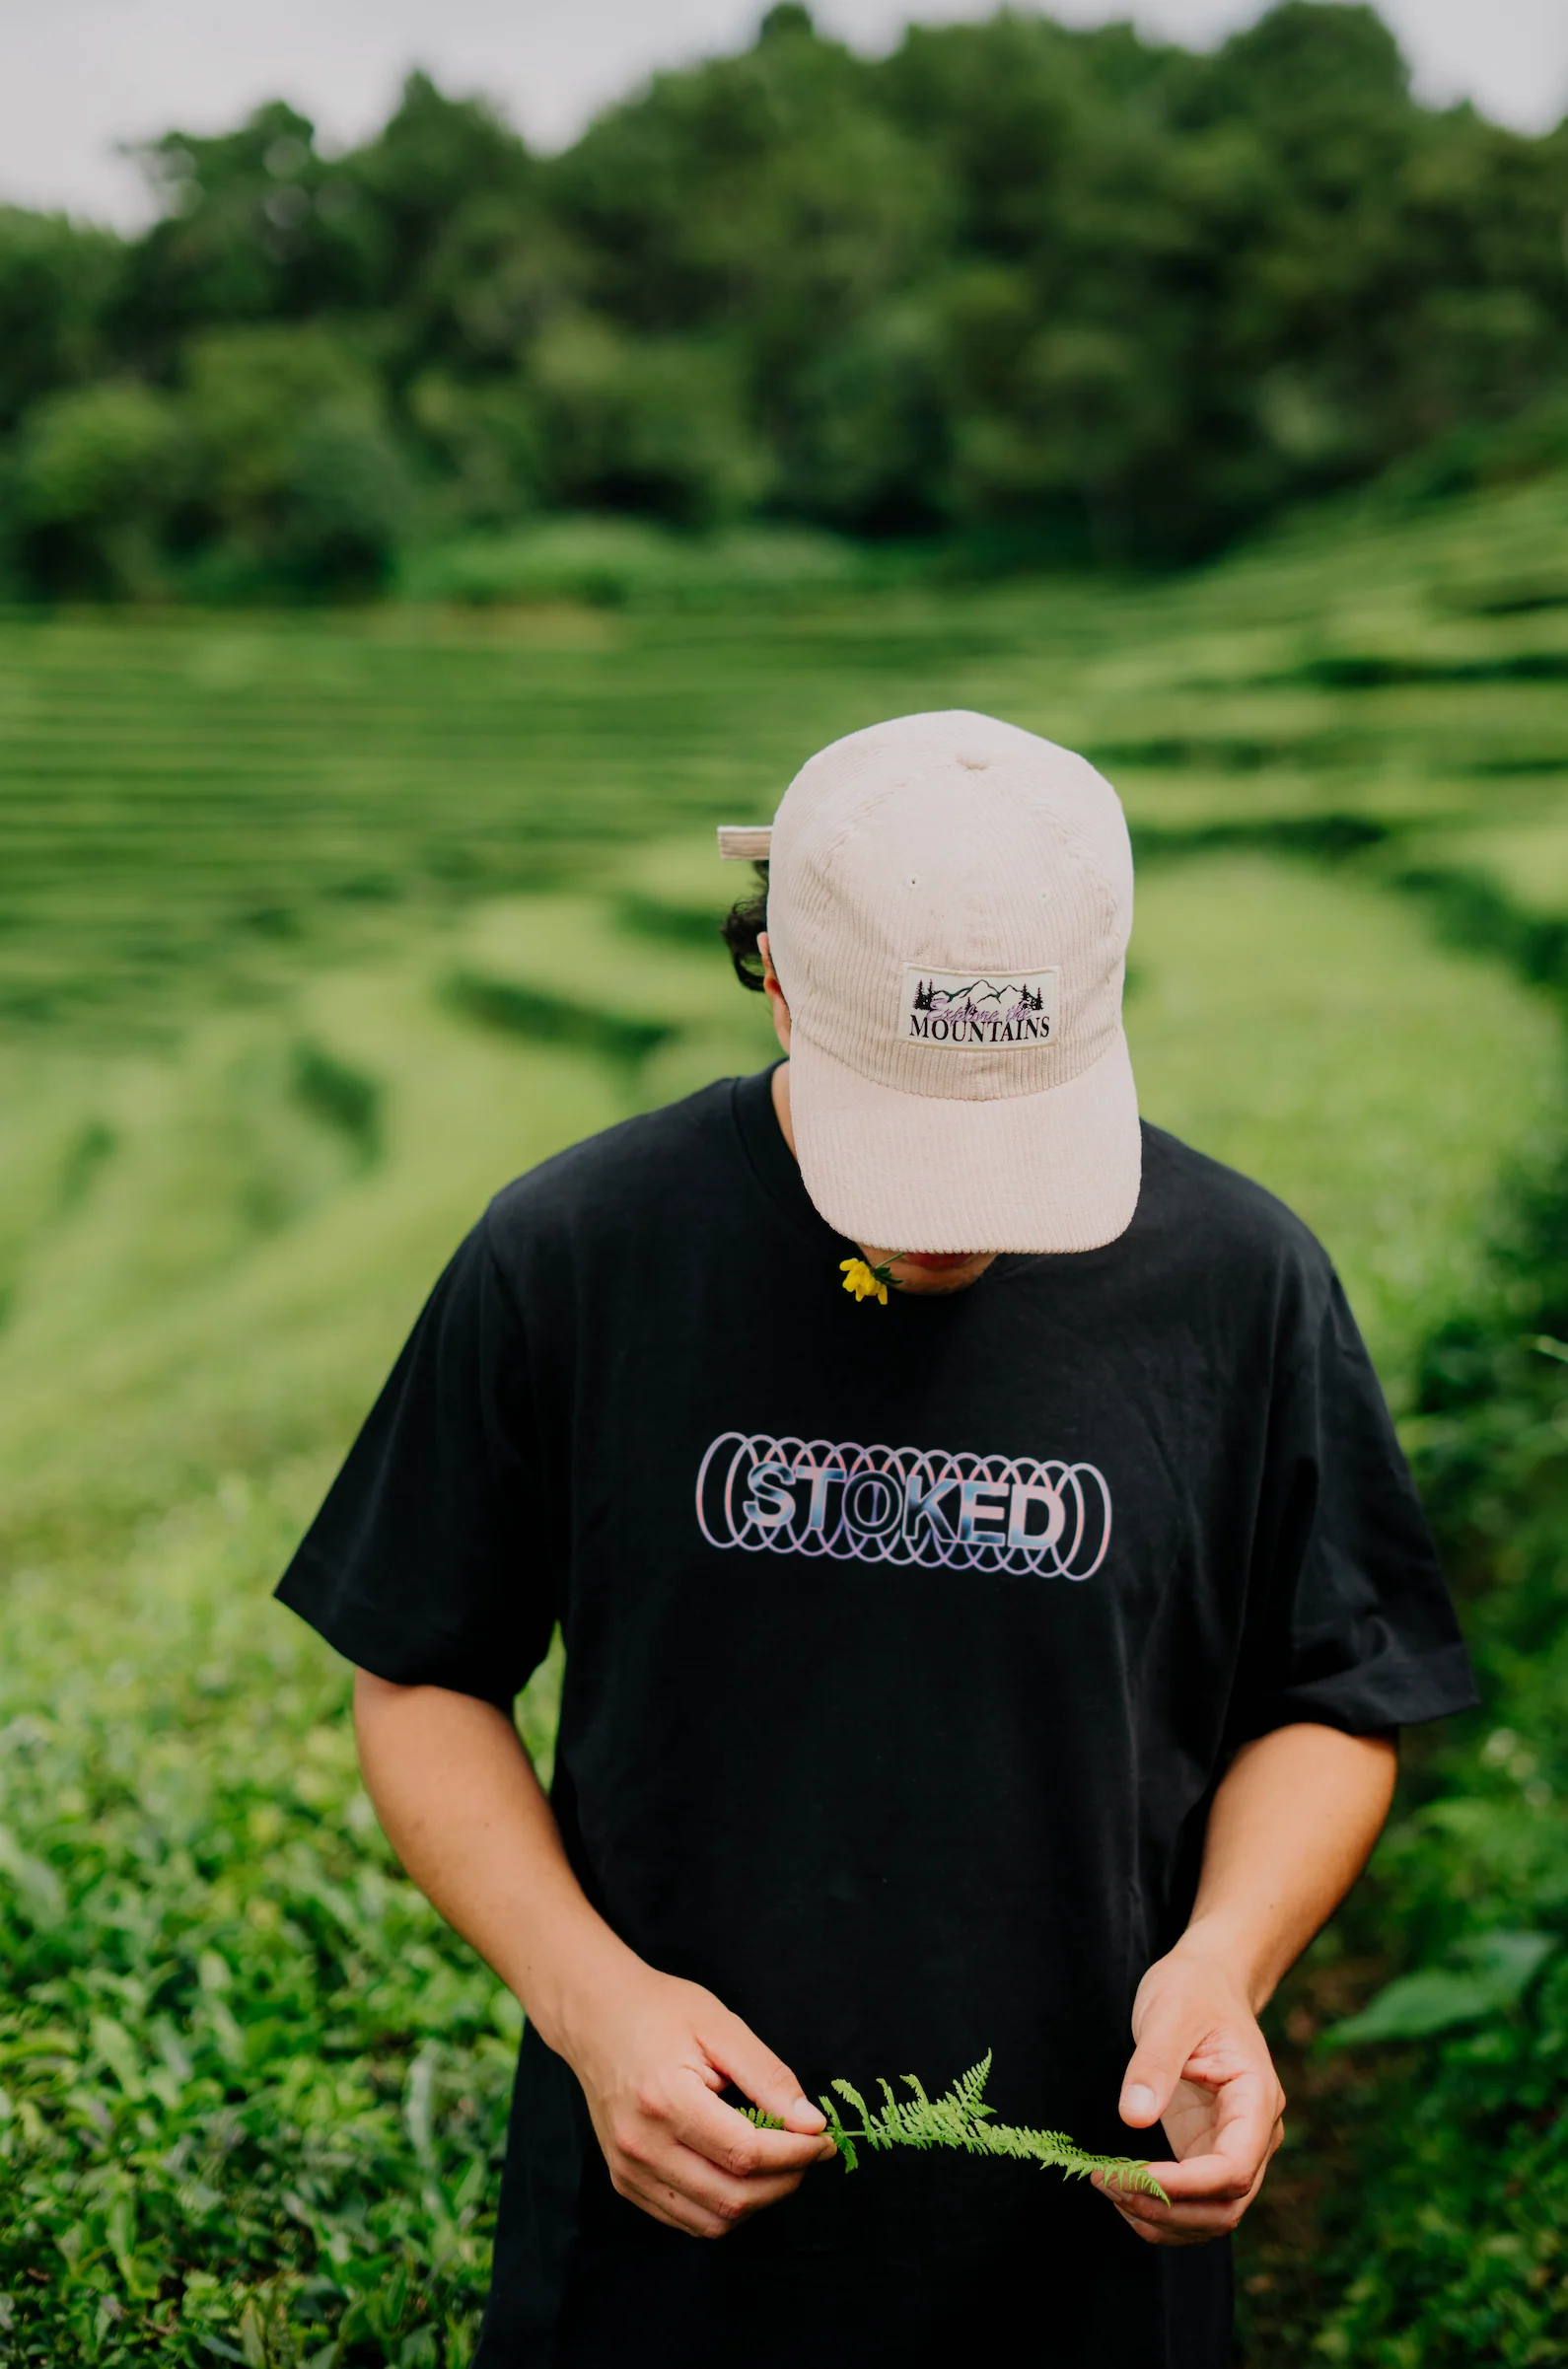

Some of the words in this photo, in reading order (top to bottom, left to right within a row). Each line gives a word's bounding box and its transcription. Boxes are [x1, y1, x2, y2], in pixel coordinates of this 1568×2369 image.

[927, 998, 999, 1026] Explore
[1006, 1000, 1033, 1022] the
[909, 1015, 1050, 1042] MOUNTAINS
[743, 1461, 1065, 1550] STOKED
